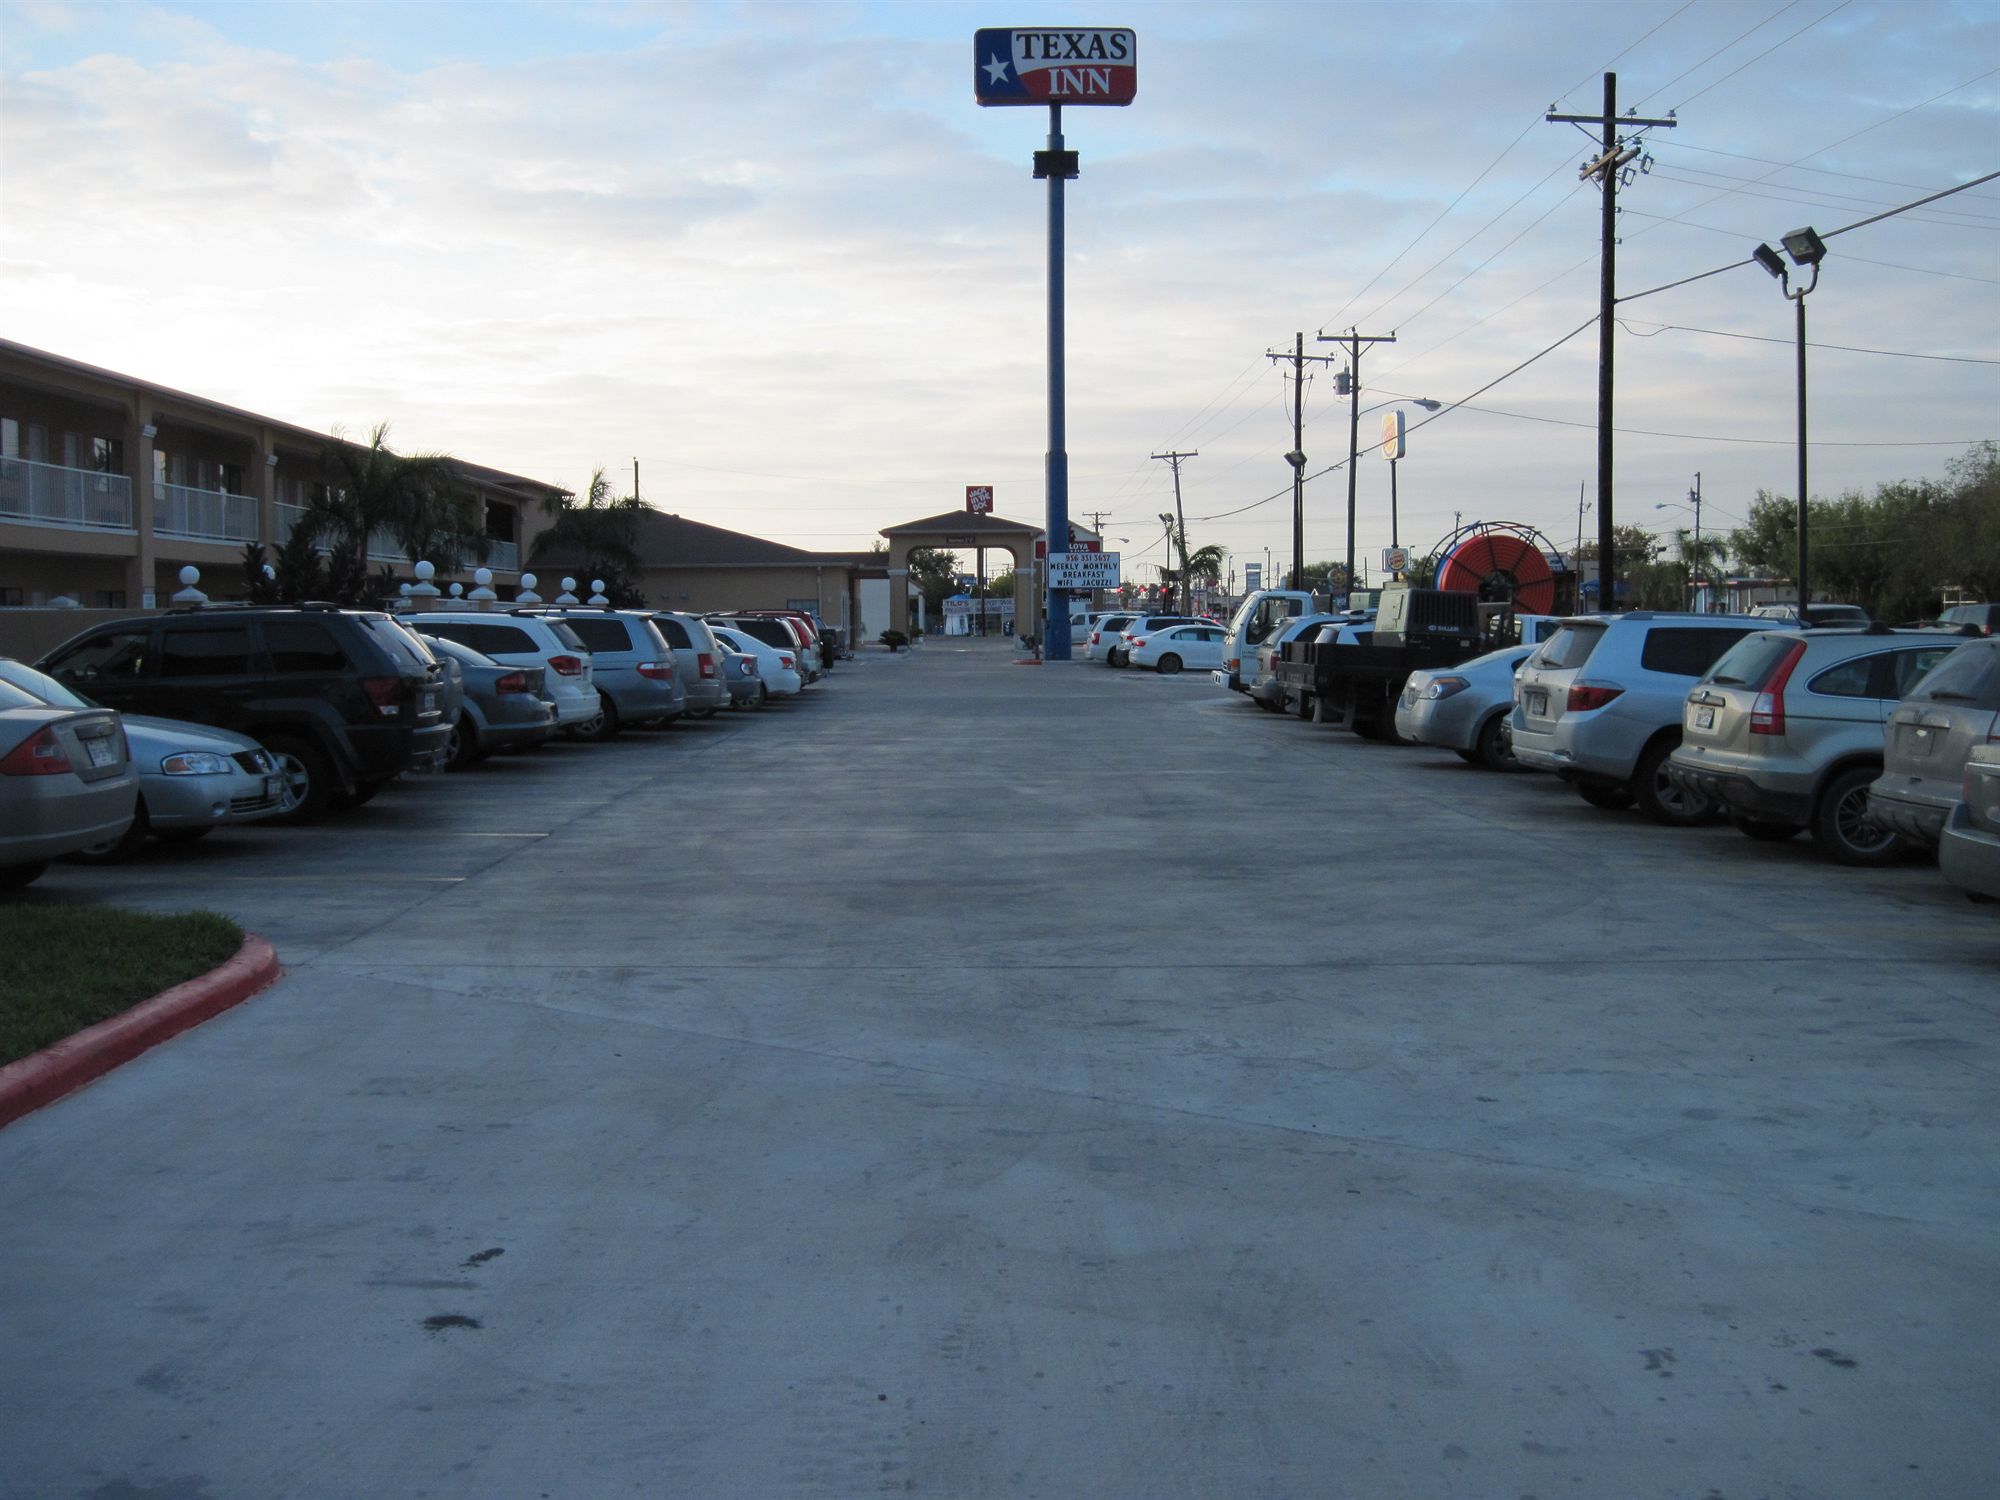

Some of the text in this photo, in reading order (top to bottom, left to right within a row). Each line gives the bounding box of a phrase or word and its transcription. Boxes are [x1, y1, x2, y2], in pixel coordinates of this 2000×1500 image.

[1016, 33, 1128, 60] TEXAS
[1048, 68, 1112, 95] INN
[1050, 562, 1118, 570] WEEKLY MONTHLY
